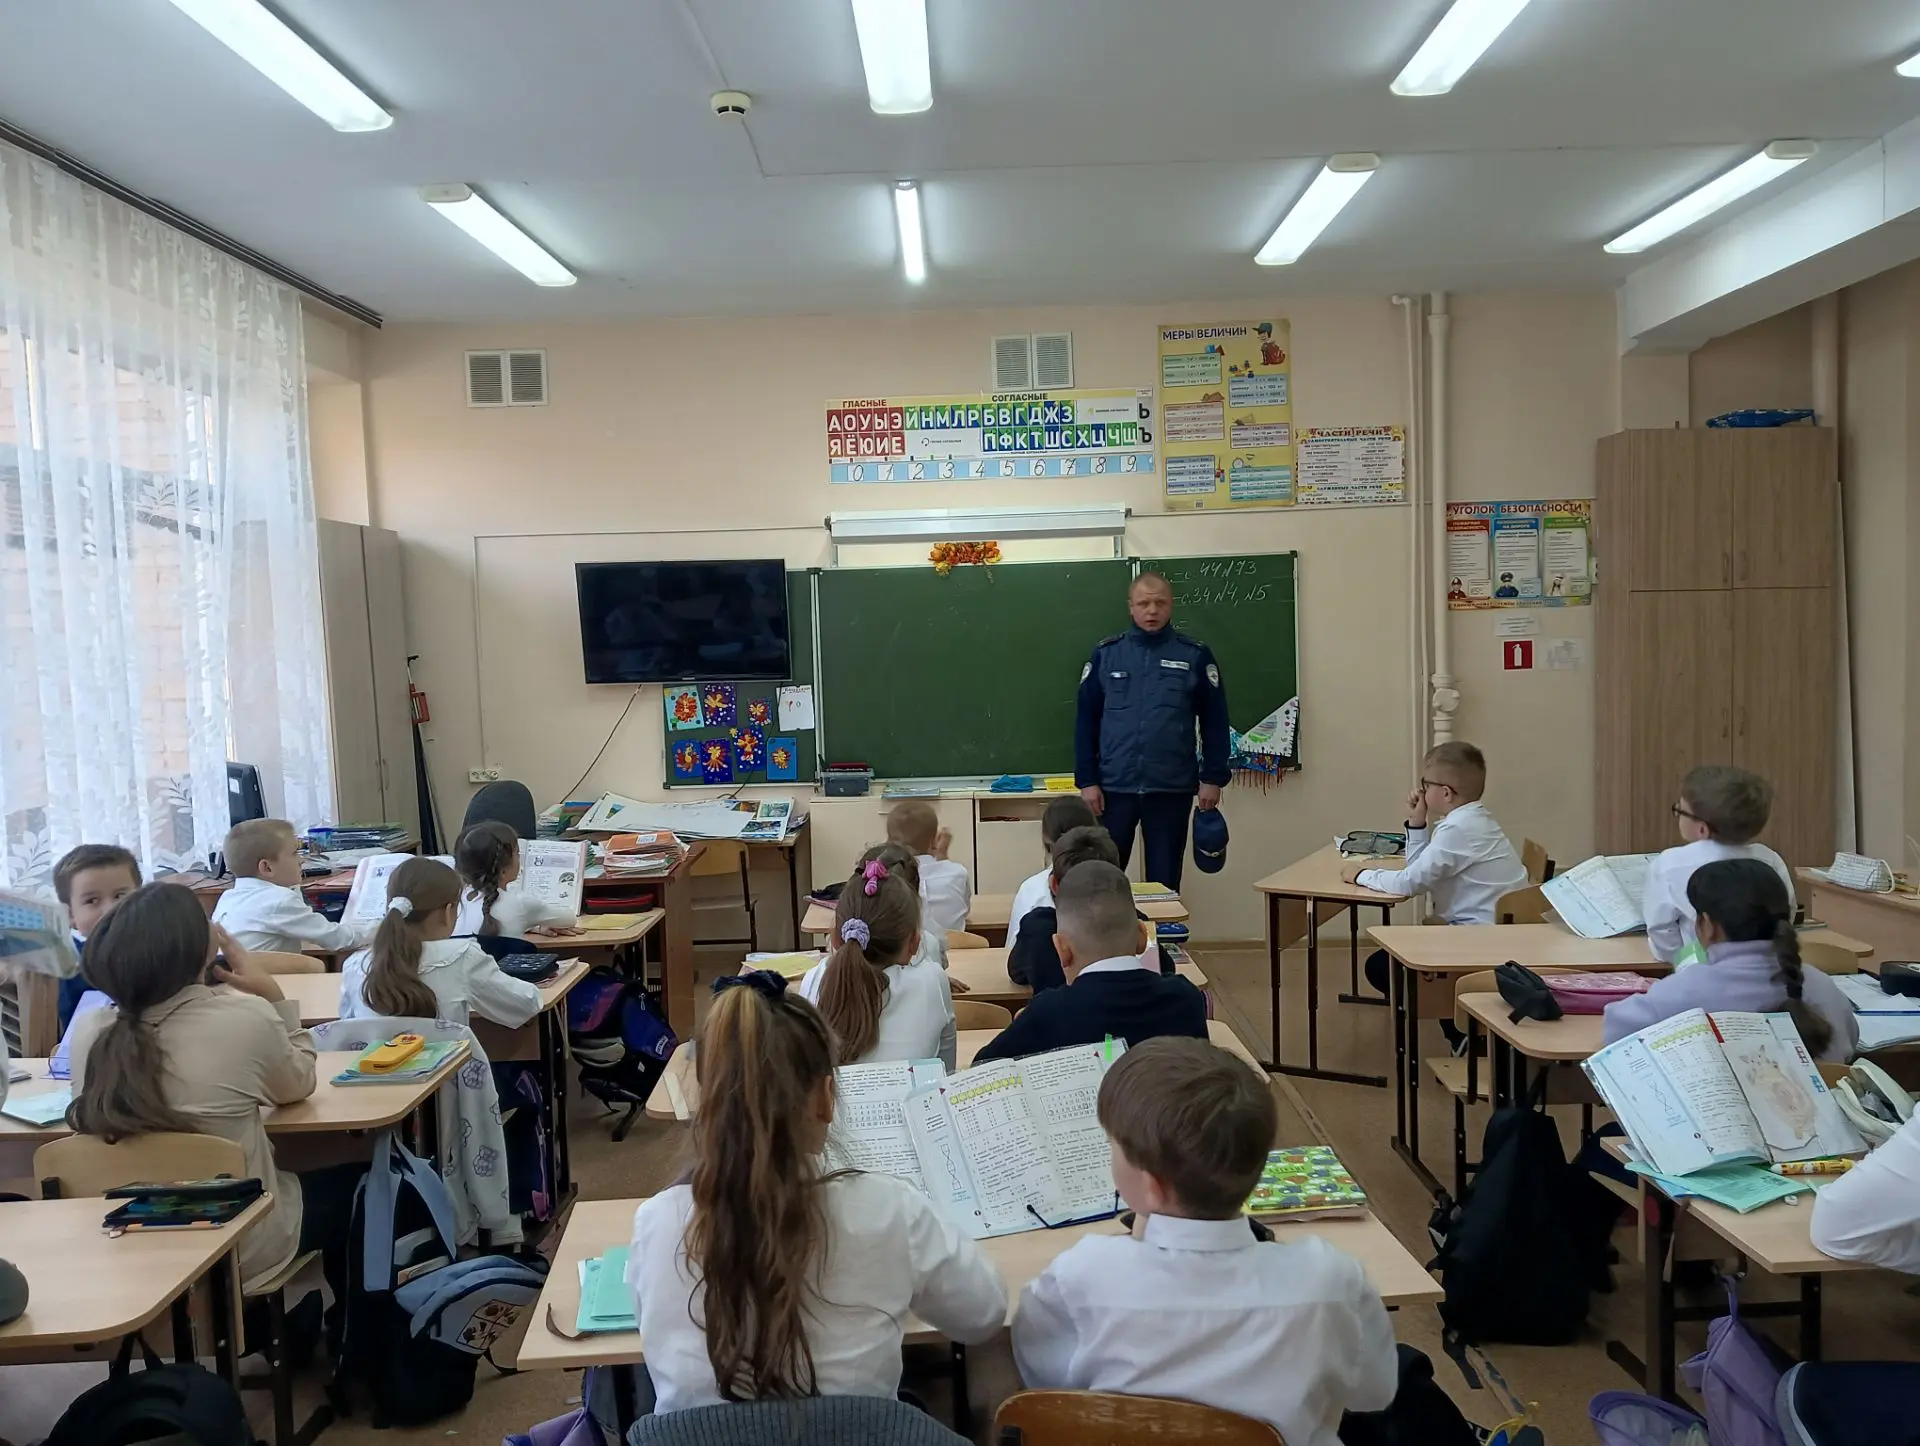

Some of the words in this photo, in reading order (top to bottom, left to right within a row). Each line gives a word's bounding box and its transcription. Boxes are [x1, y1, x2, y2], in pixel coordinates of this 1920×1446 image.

[1162, 329, 1194, 341] МЕРЫ
[1197, 326, 1247, 339] ВЕЛИЧИН
[991, 392, 1049, 403] СОГЛАСНЫЕ
[842, 399, 887, 409] ГЛАСНЫЕ
[1317, 429, 1351, 437] ЧАСТИ
[1355, 428, 1383, 436] РЕЧИ
[852, 464, 864, 482] 0
[886, 463, 894, 481] 1
[912, 462, 925, 480] 2
[942, 461, 955, 479] 3
[975, 460, 985, 478] 4
[1004, 459, 1015, 477] 5
[1034, 458, 1045, 476] 6
[1065, 458, 1076, 476] 7
[1095, 456, 1107, 474] 8
[1125, 455, 1137, 473] 9
[1452, 505, 1496, 515] УГОЛОК
[1500, 503, 1582, 514] БЕЗОПАСНОСТИ
